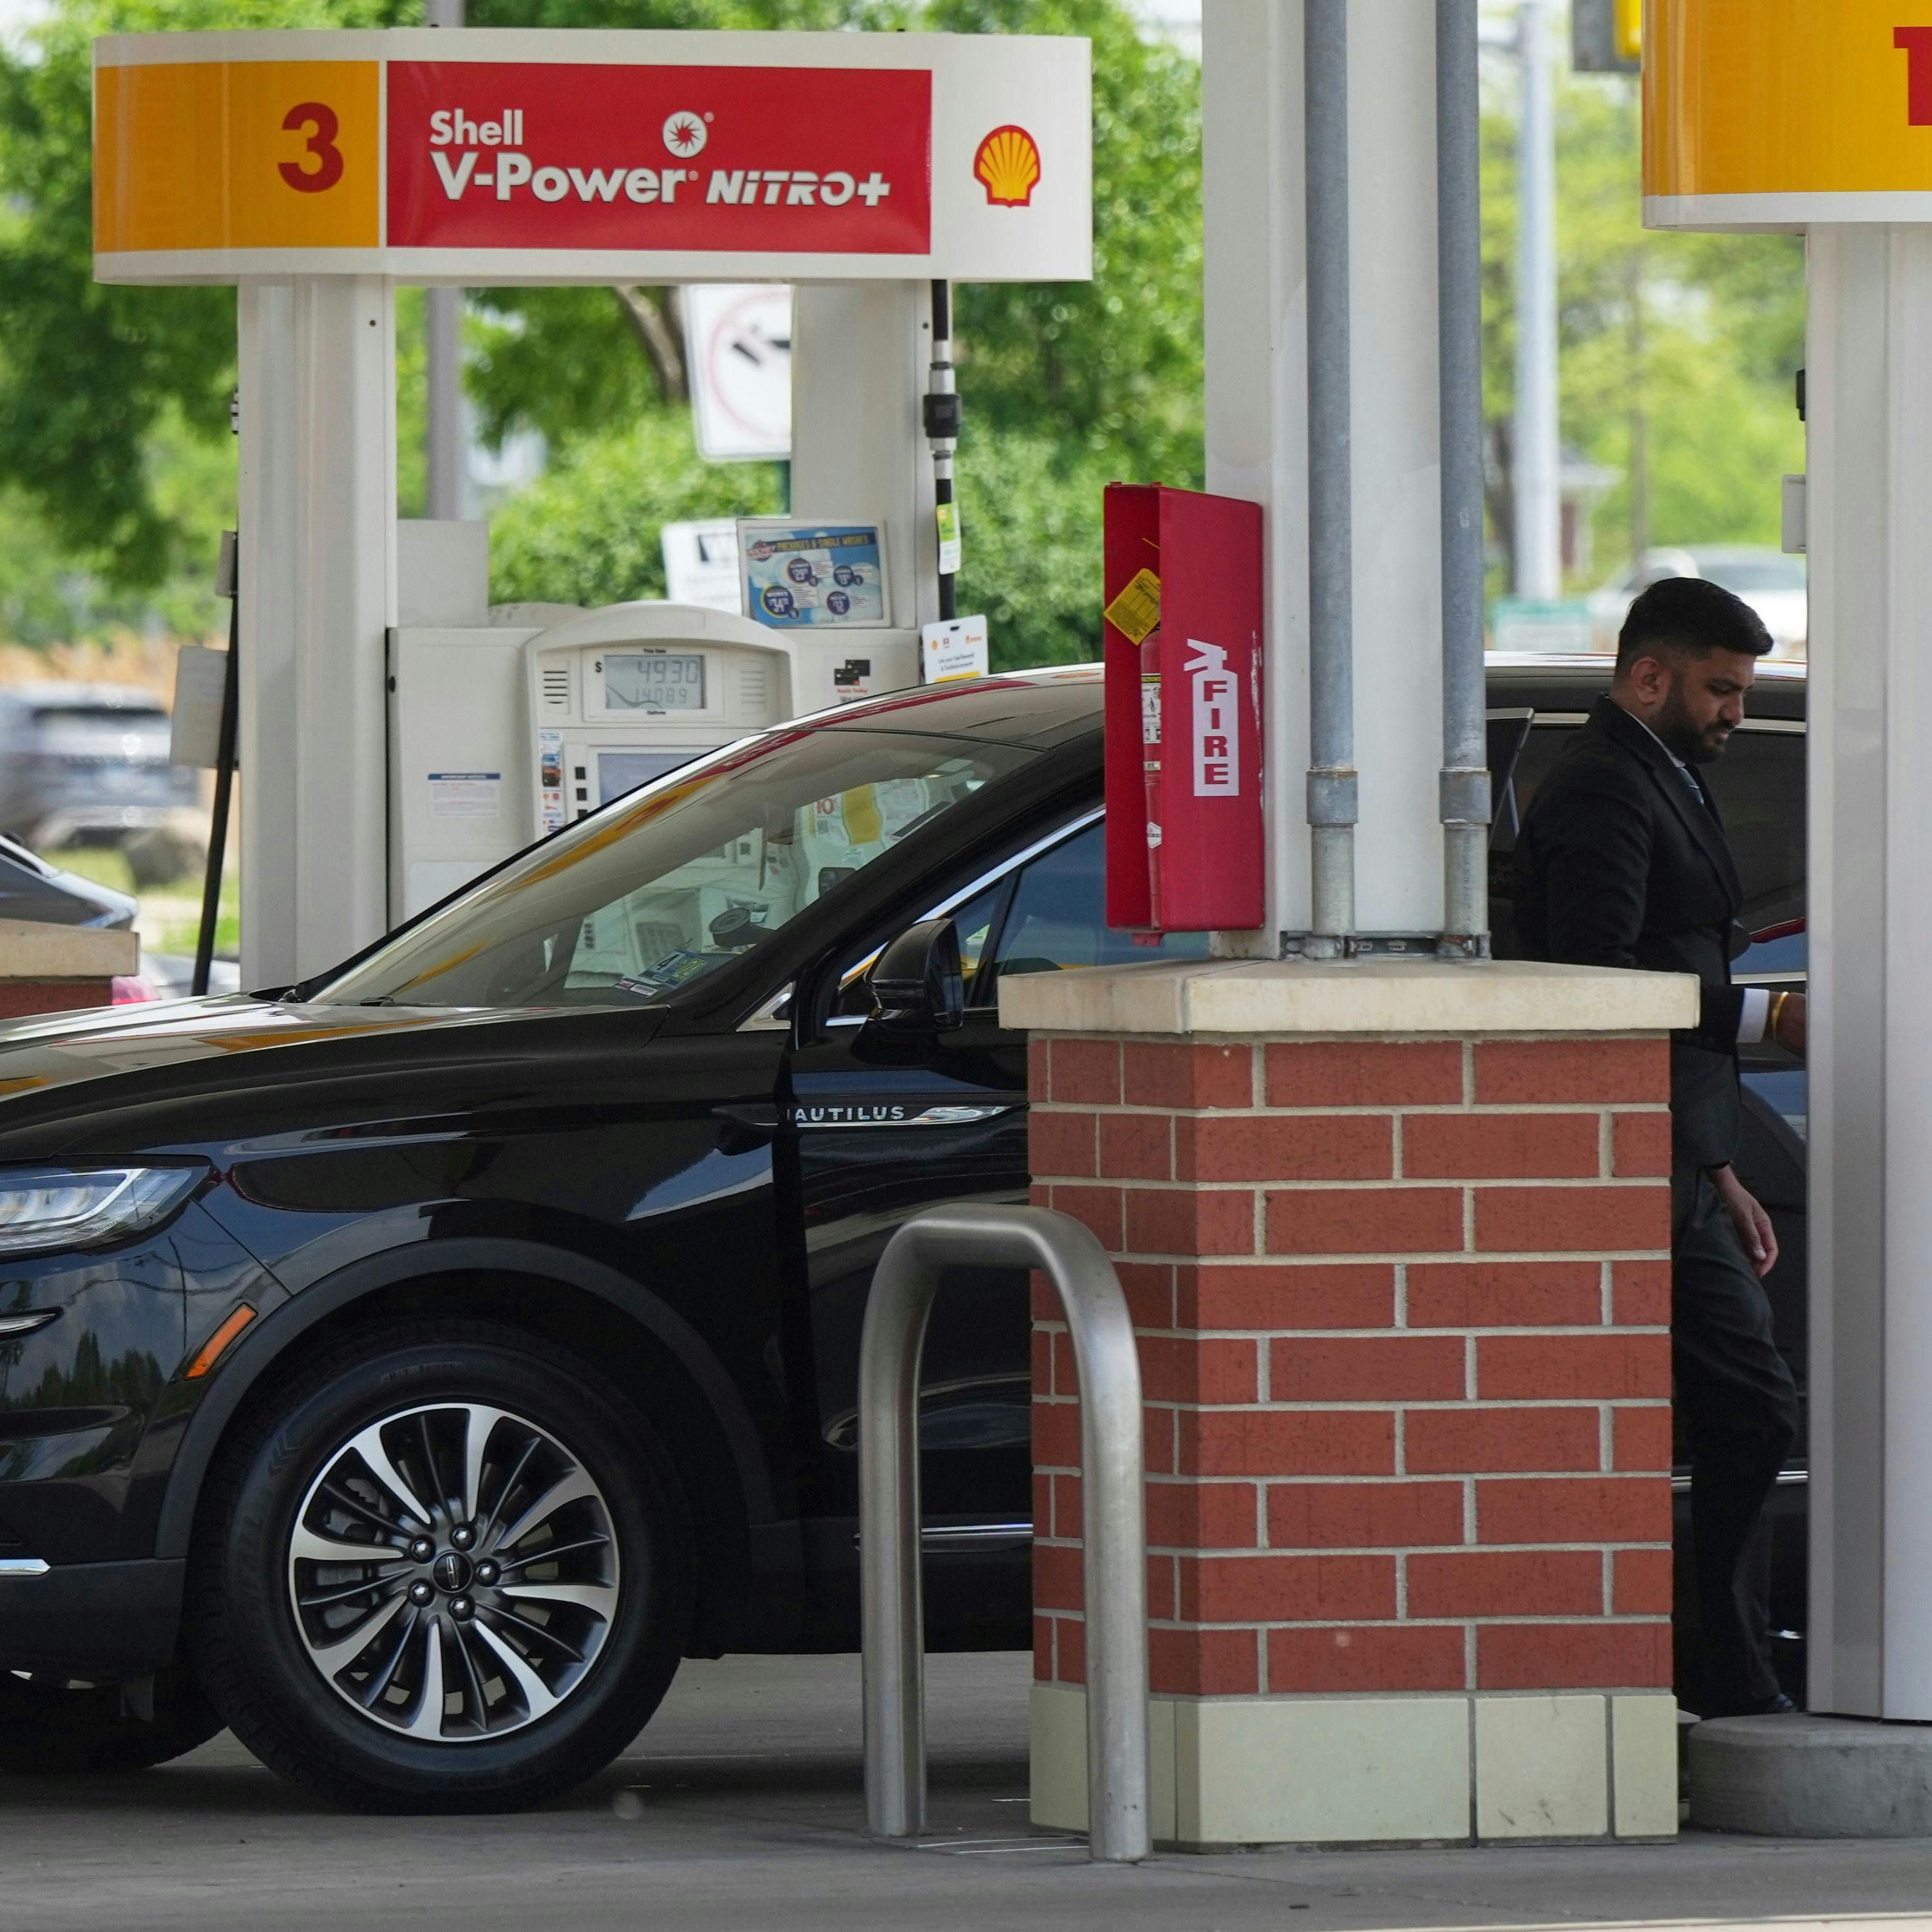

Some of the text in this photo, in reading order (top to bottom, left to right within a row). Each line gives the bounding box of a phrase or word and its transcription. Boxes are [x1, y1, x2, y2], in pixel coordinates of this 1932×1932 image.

[430, 108, 524, 146] Shell
[278, 102, 343, 193] 3
[595, 661, 602, 673] $
[1204, 681, 1228, 785] FIRE
[786, 1106, 904, 1121] AUTILUS
